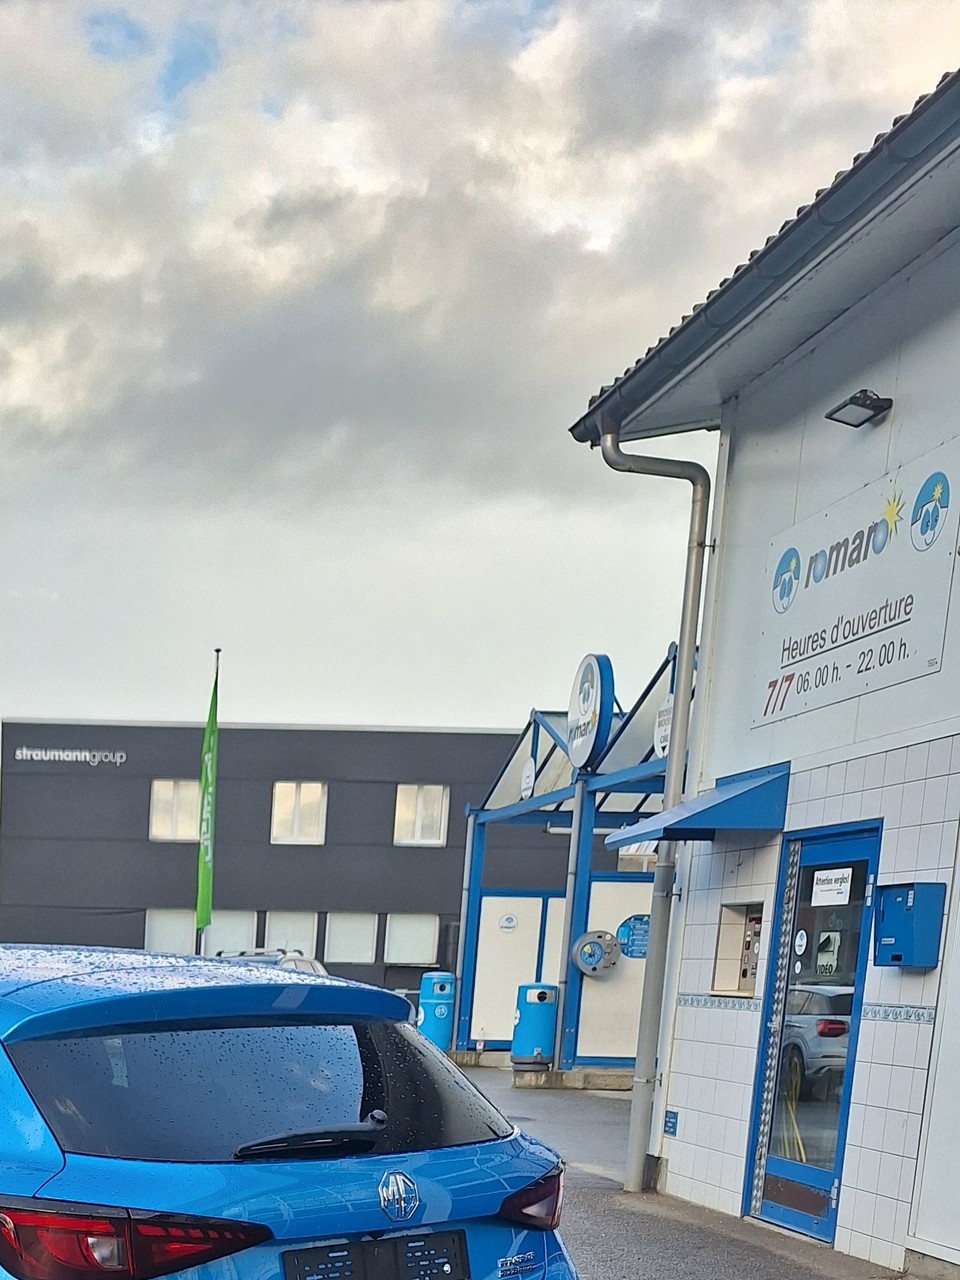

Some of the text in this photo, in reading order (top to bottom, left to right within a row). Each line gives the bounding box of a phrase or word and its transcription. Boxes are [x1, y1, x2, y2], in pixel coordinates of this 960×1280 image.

[804, 518, 889, 589] romaro
[781, 594, 914, 663] Heures d'ouverture
[763, 672, 796, 717] 7/7
[14, 746, 127, 767] straumanngroup
